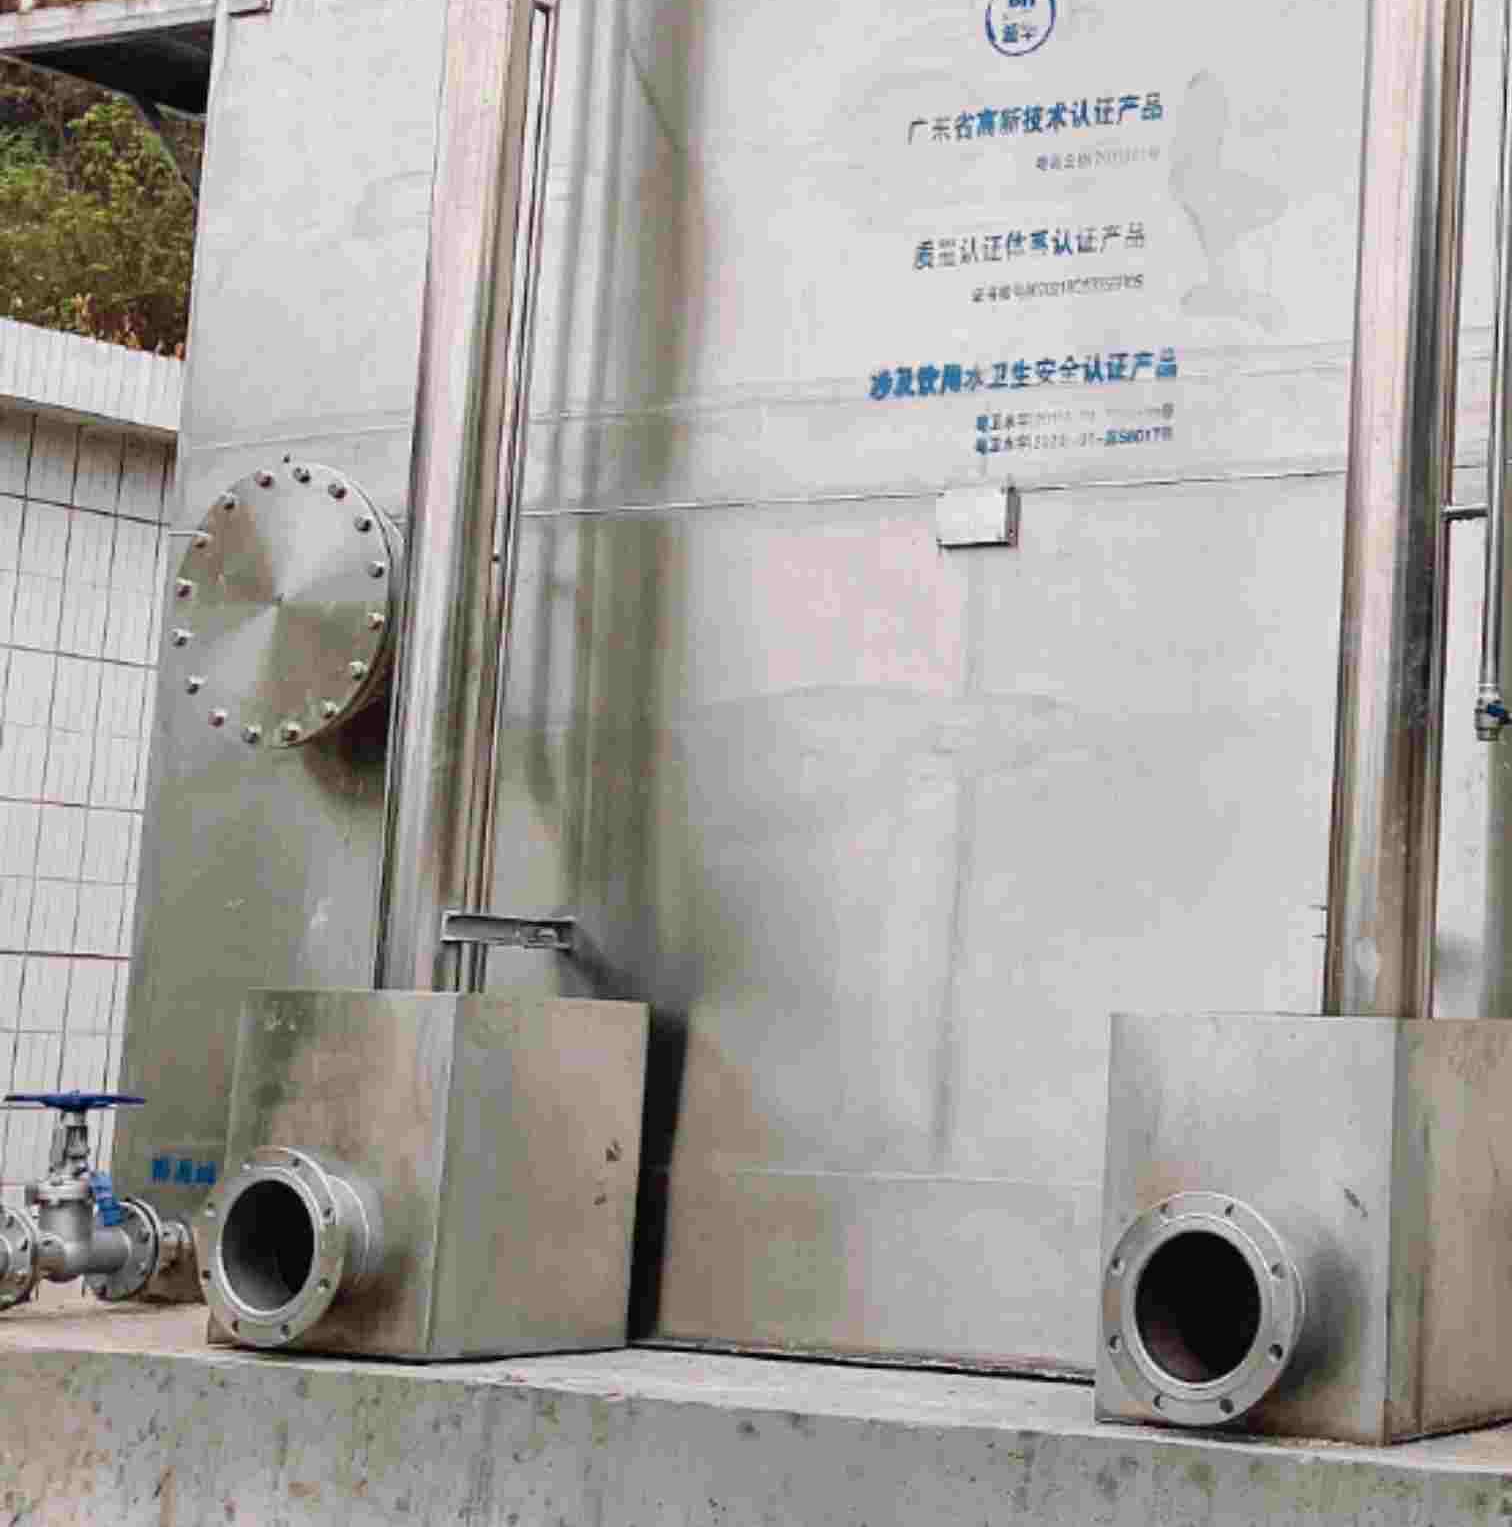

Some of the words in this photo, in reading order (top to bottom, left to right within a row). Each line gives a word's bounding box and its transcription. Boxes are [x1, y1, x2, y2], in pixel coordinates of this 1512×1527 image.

[907, 91, 1162, 145] 广东省高新技术认证产品
[869, 346, 1178, 400] 涉及饮用水卫生安全认证产品
